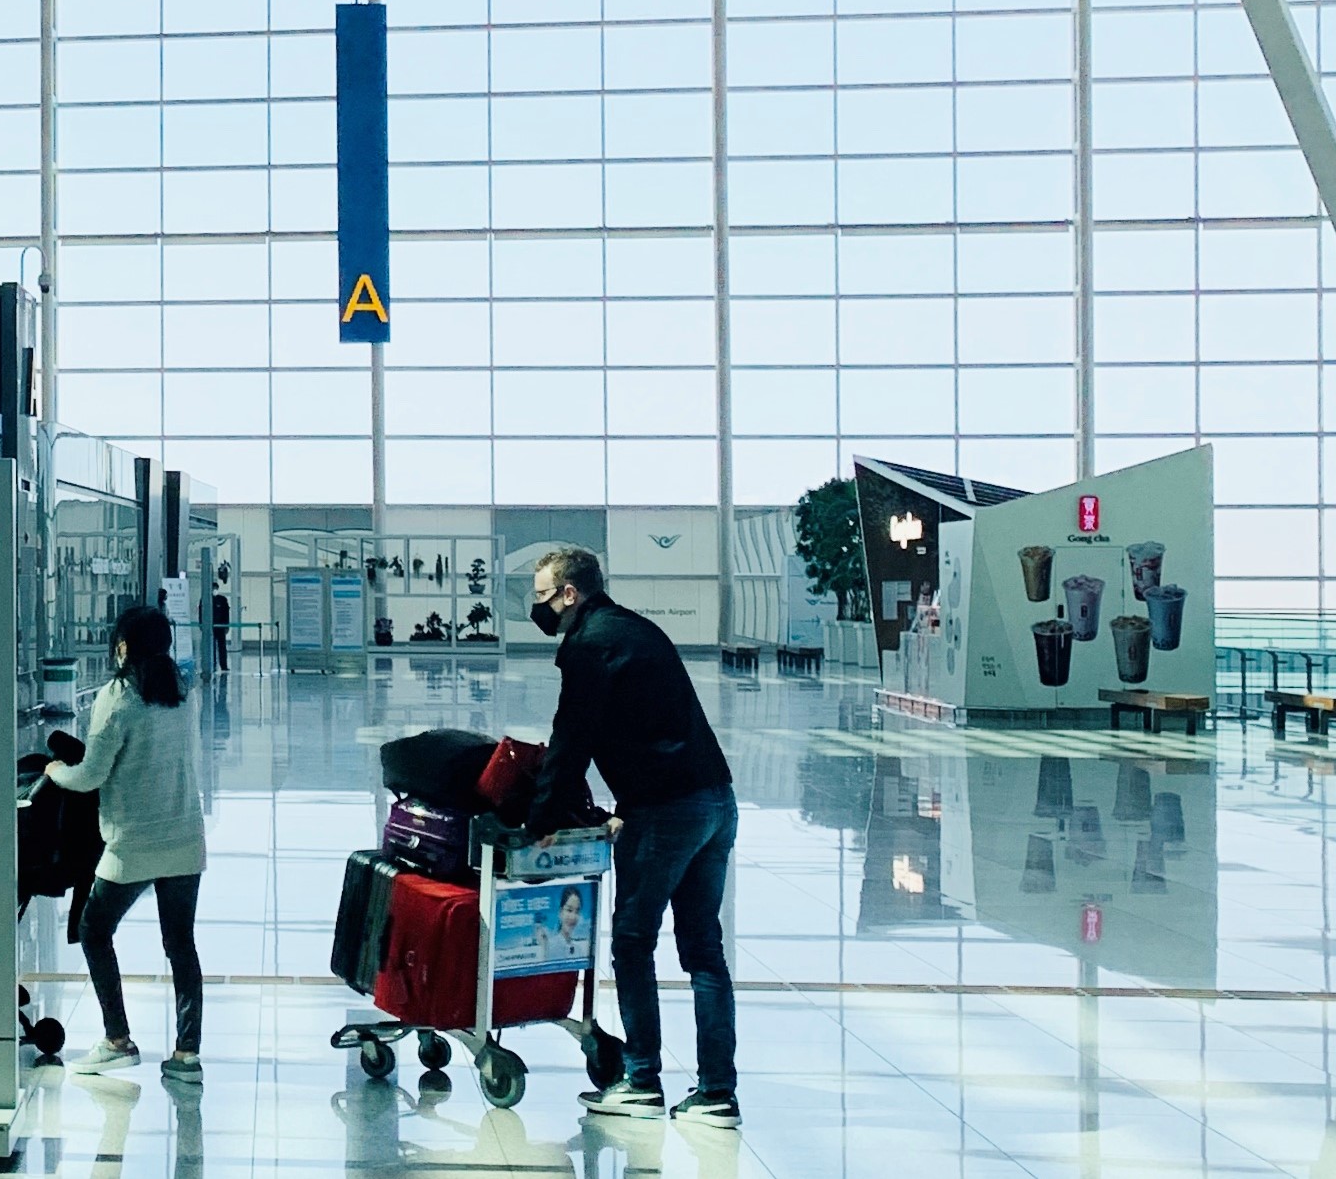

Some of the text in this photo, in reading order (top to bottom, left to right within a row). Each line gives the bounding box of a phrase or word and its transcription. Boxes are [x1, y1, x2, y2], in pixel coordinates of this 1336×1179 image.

[341, 273, 389, 323] A
[1067, 534, 1110, 544] Gong cha
[668, 607, 697, 617] Airport
